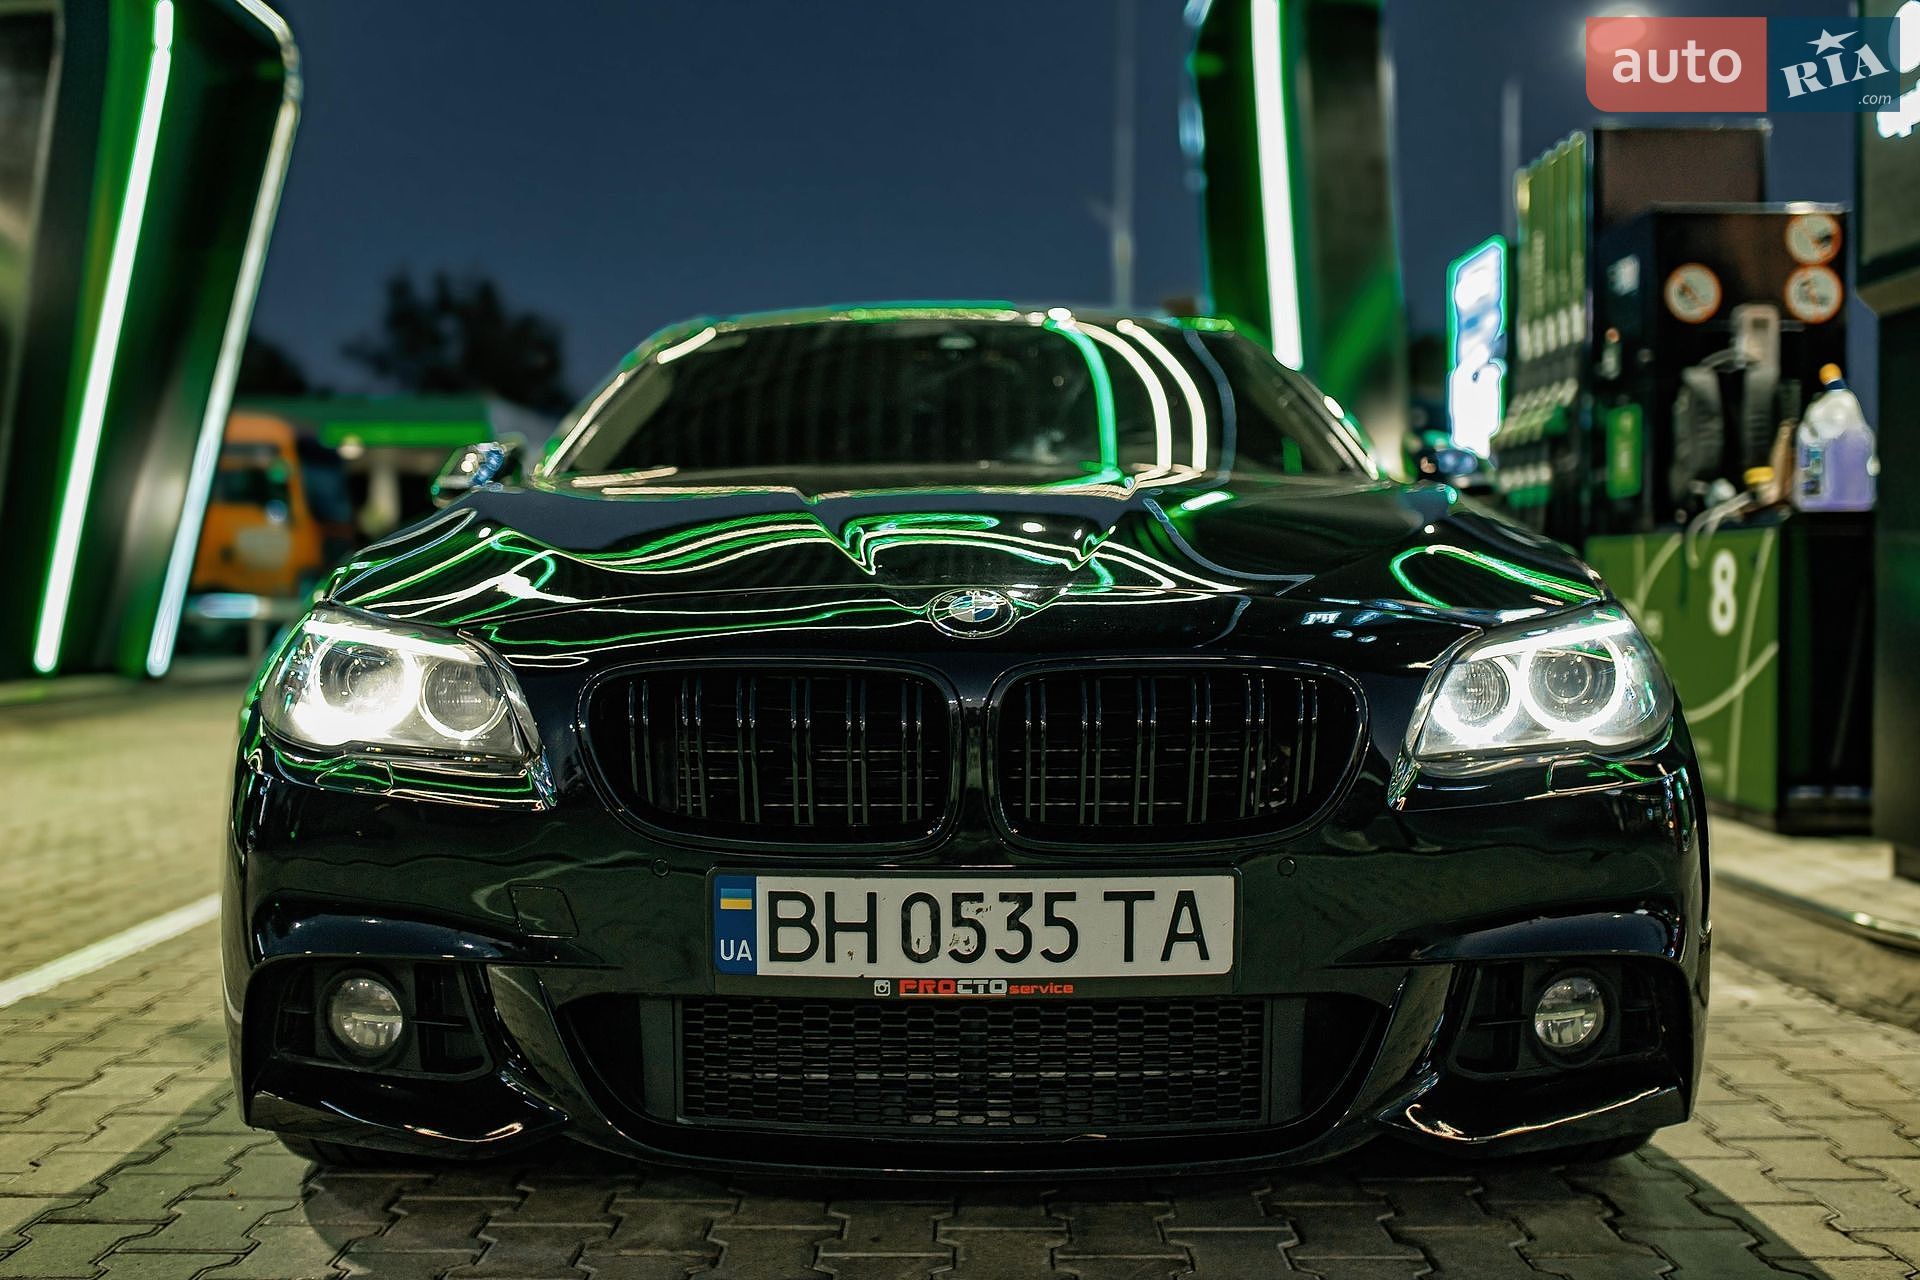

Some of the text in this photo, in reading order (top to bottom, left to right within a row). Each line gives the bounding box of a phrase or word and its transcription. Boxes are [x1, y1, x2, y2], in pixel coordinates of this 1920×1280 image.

[1711, 549, 1737, 635] 8
[720, 939, 752, 962] UA
[768, 890, 1211, 964] BH 0535 TA
